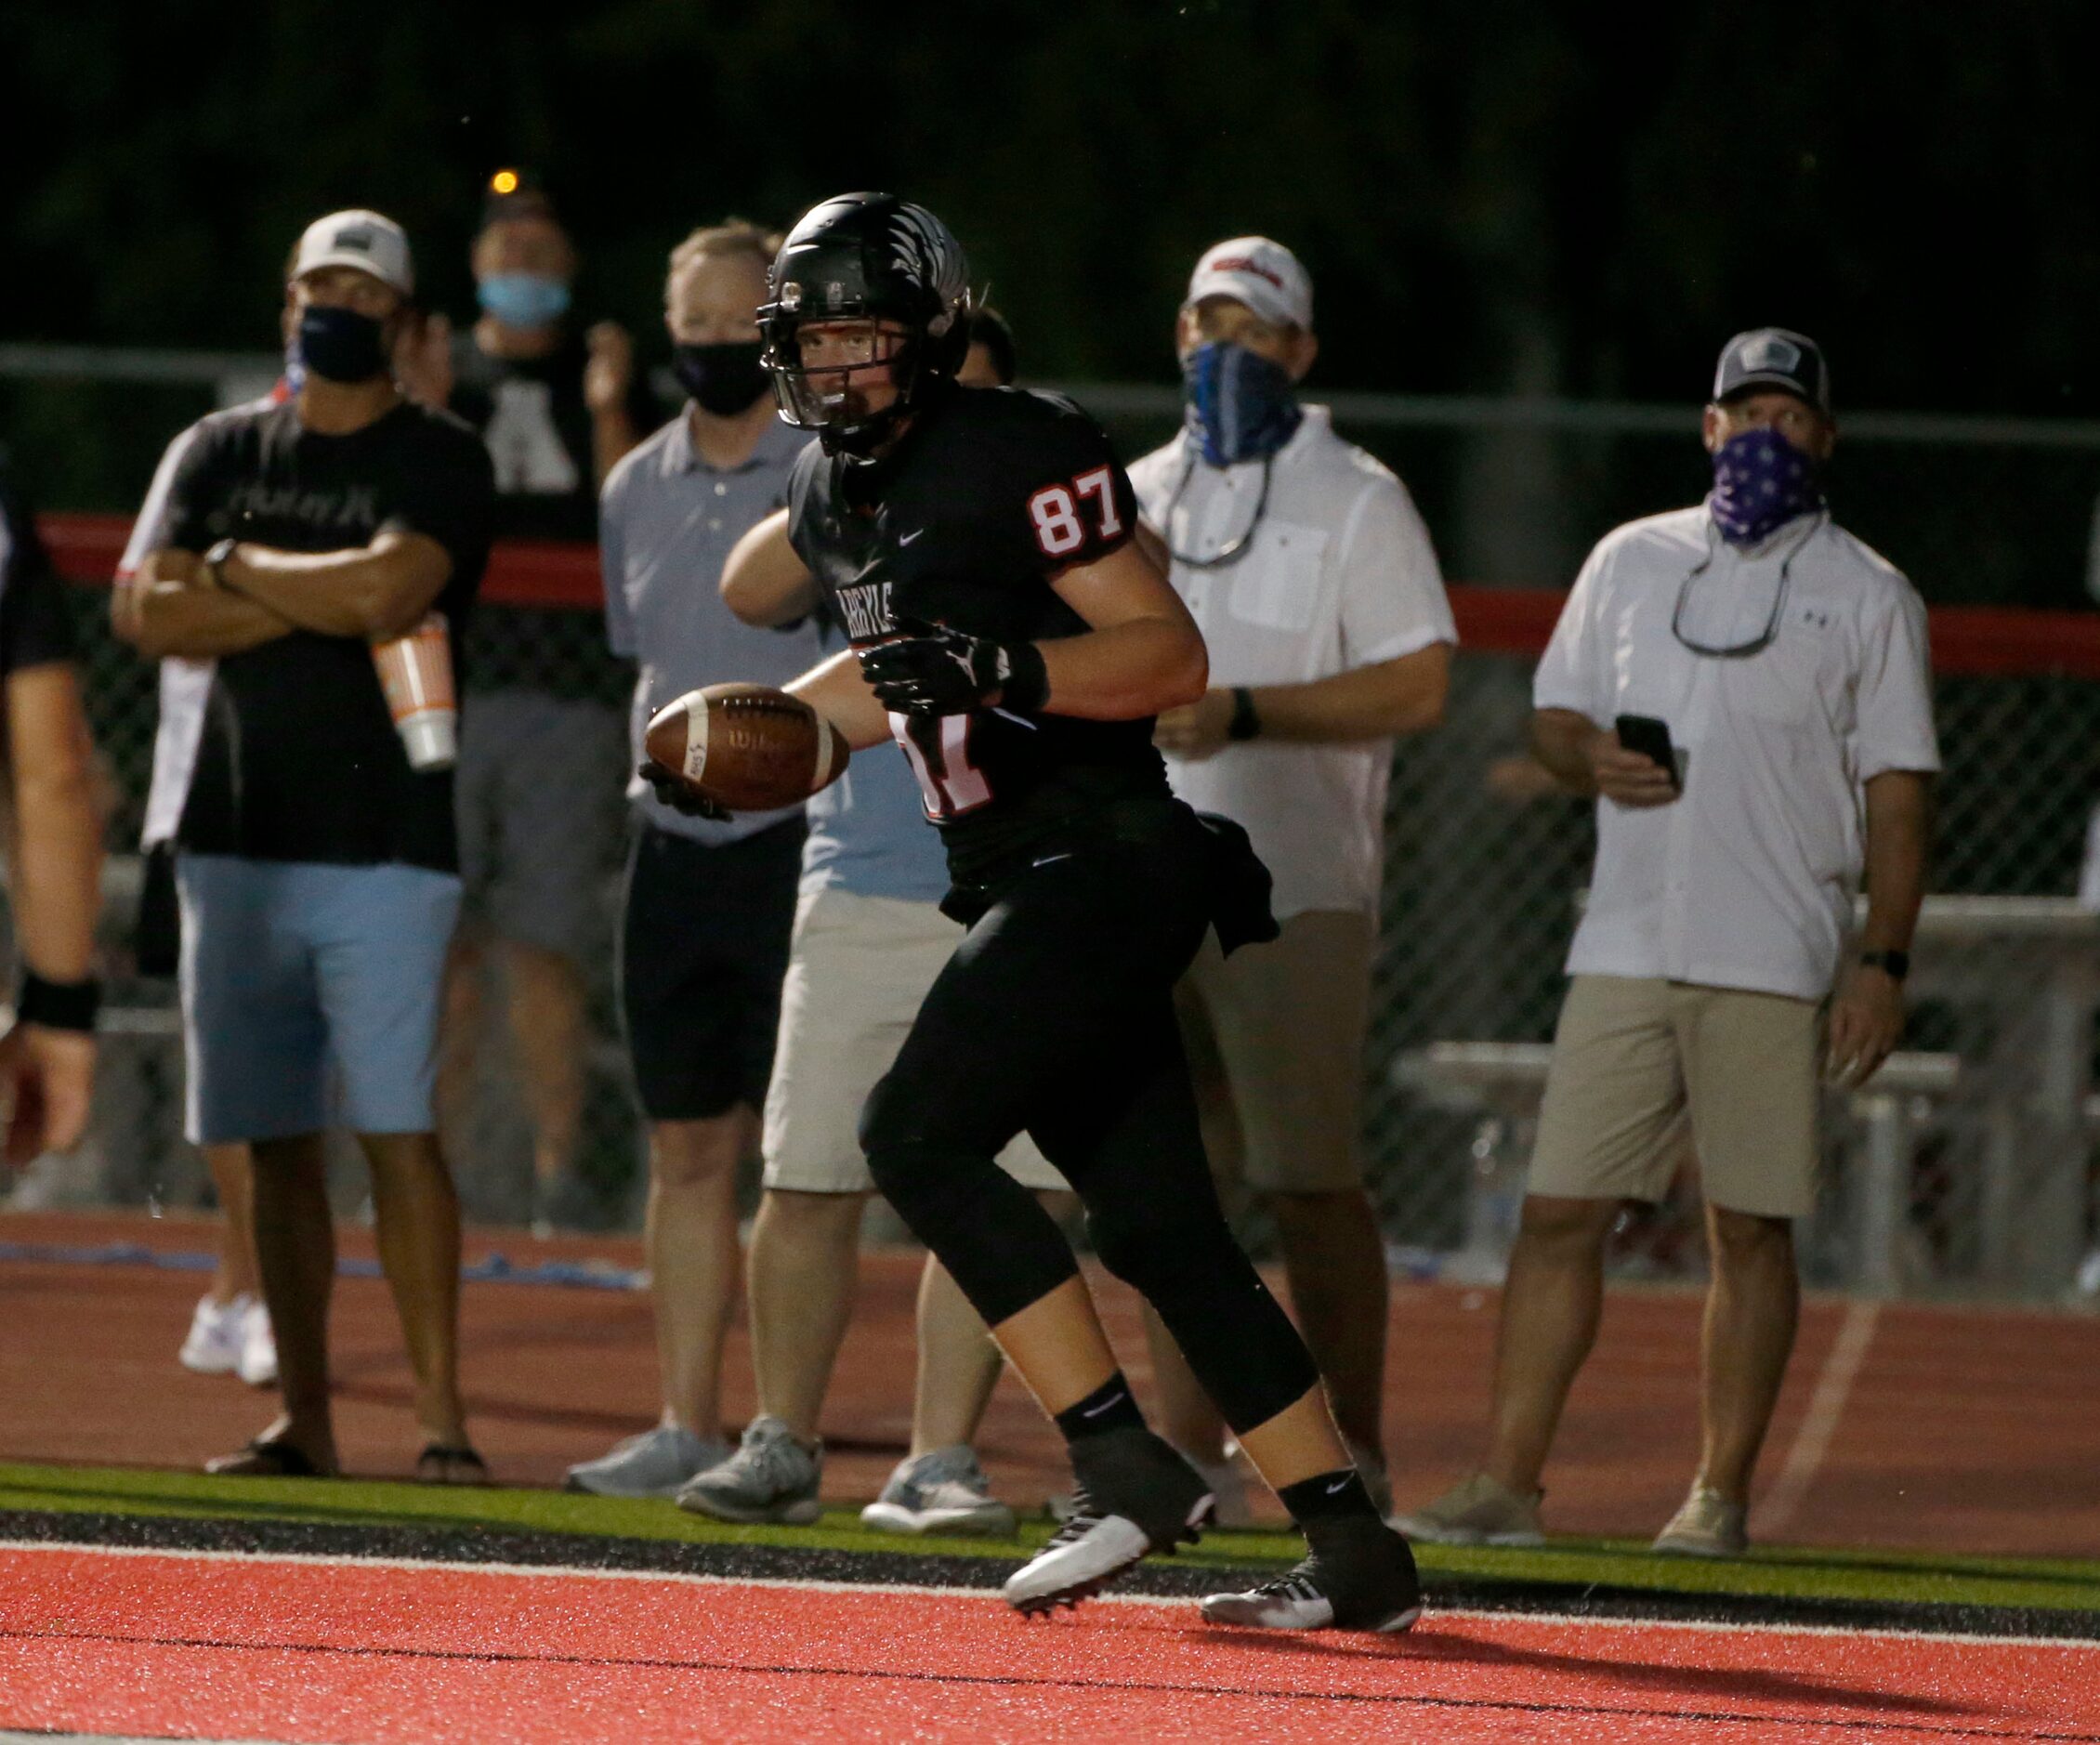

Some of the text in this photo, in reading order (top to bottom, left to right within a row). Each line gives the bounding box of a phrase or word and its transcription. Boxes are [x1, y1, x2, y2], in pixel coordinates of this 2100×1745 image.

[1026, 464, 1122, 558] 87
[835, 582, 894, 639] ARGYLE
[887, 711, 993, 818] 7
